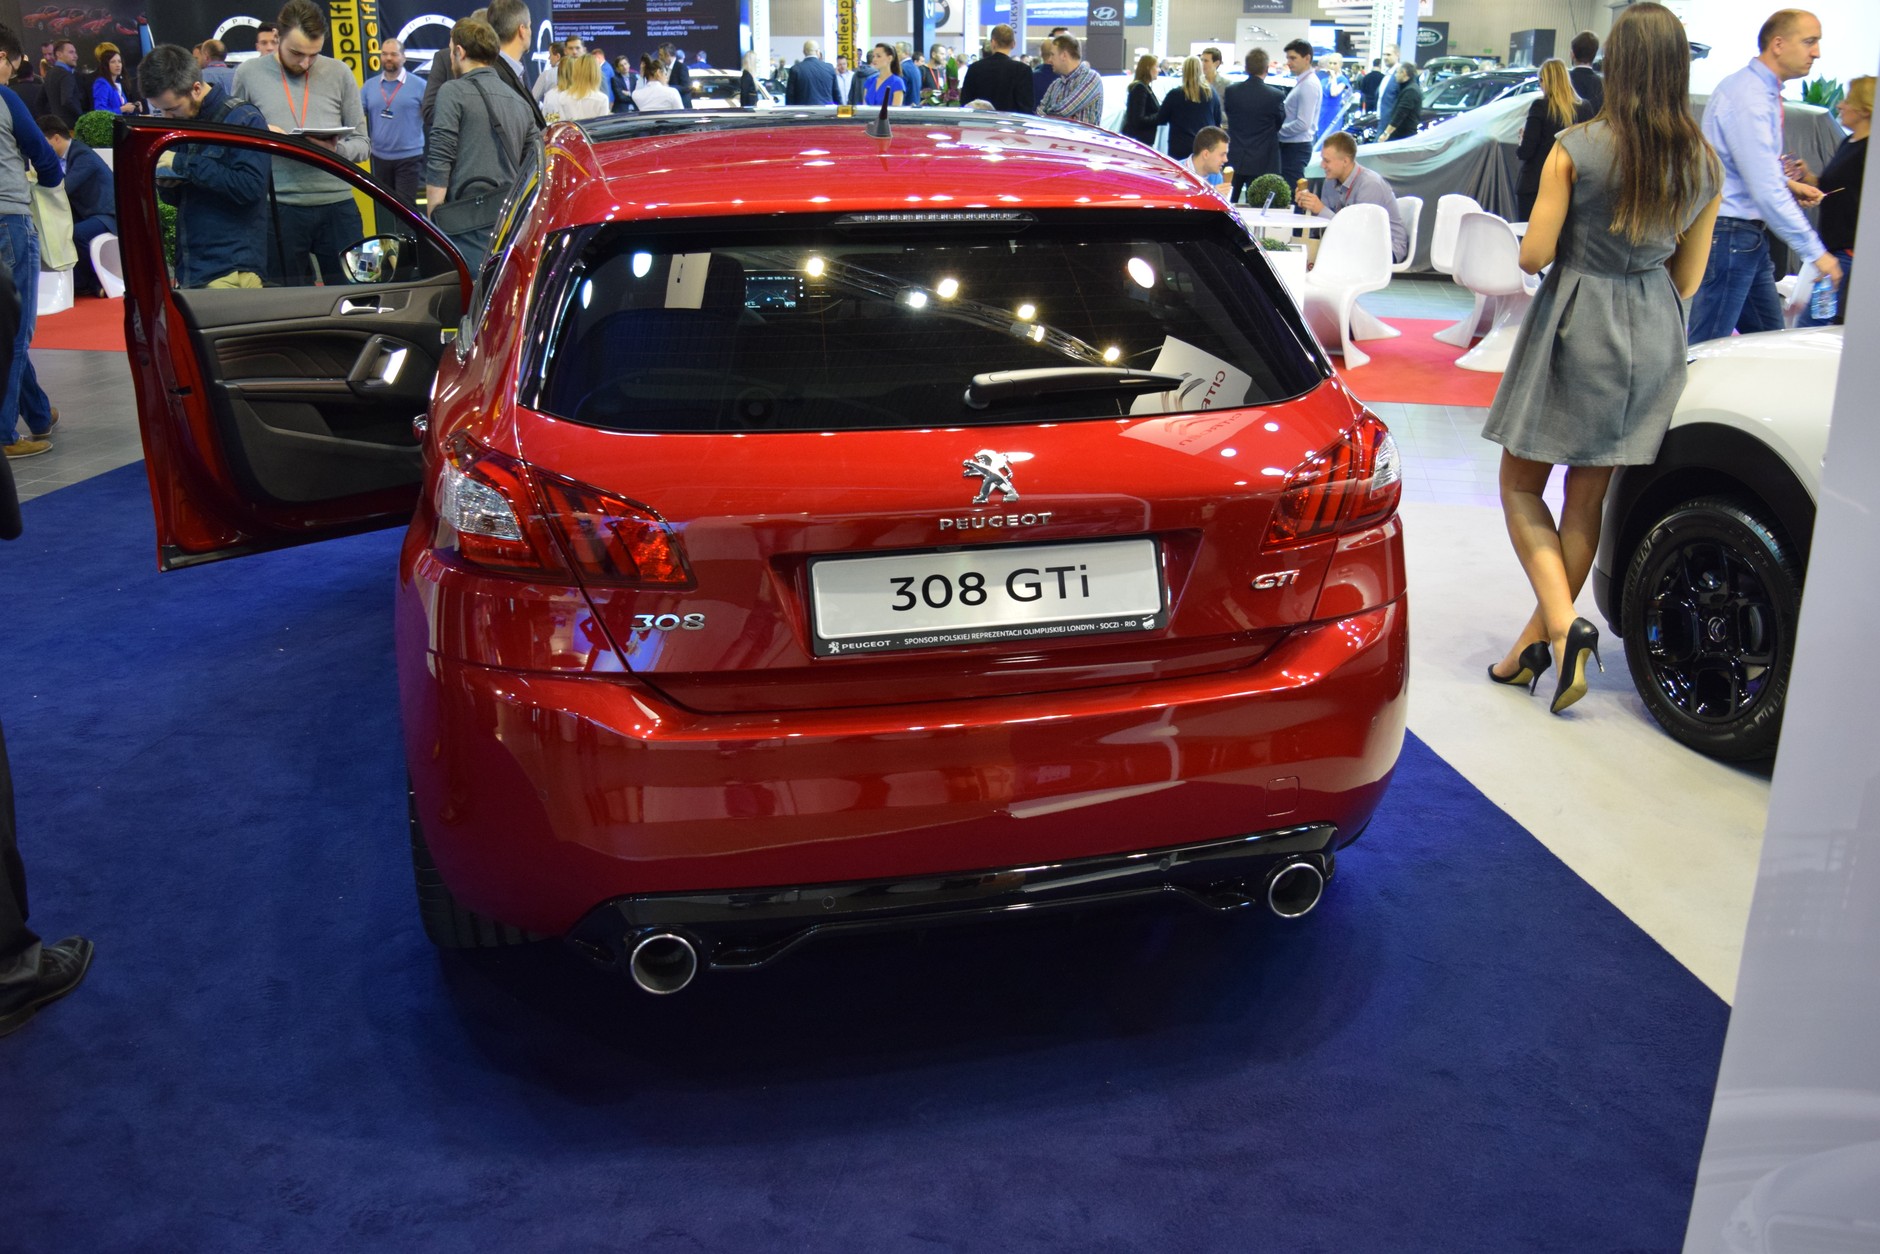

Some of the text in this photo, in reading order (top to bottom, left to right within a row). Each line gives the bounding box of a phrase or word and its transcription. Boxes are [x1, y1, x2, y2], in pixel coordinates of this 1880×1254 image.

[219, 18, 253, 33] OPE
[940, 512, 1052, 530] PEUGEOT
[890, 564, 1089, 611] 308 GTi
[630, 613, 706, 631] 308
[841, 640, 891, 650] PEUGEOT
[904, 635, 939, 645] SPONSOR
[939, 633, 971, 643] POLSKIEJ
[971, 629, 1022, 639] REPREZENTACJI
[1023, 626, 1066, 635] OLIMPIJSKIEJ
[1067, 623, 1095, 632] LONDYN
[1100, 622, 1120, 630] SOCZI
